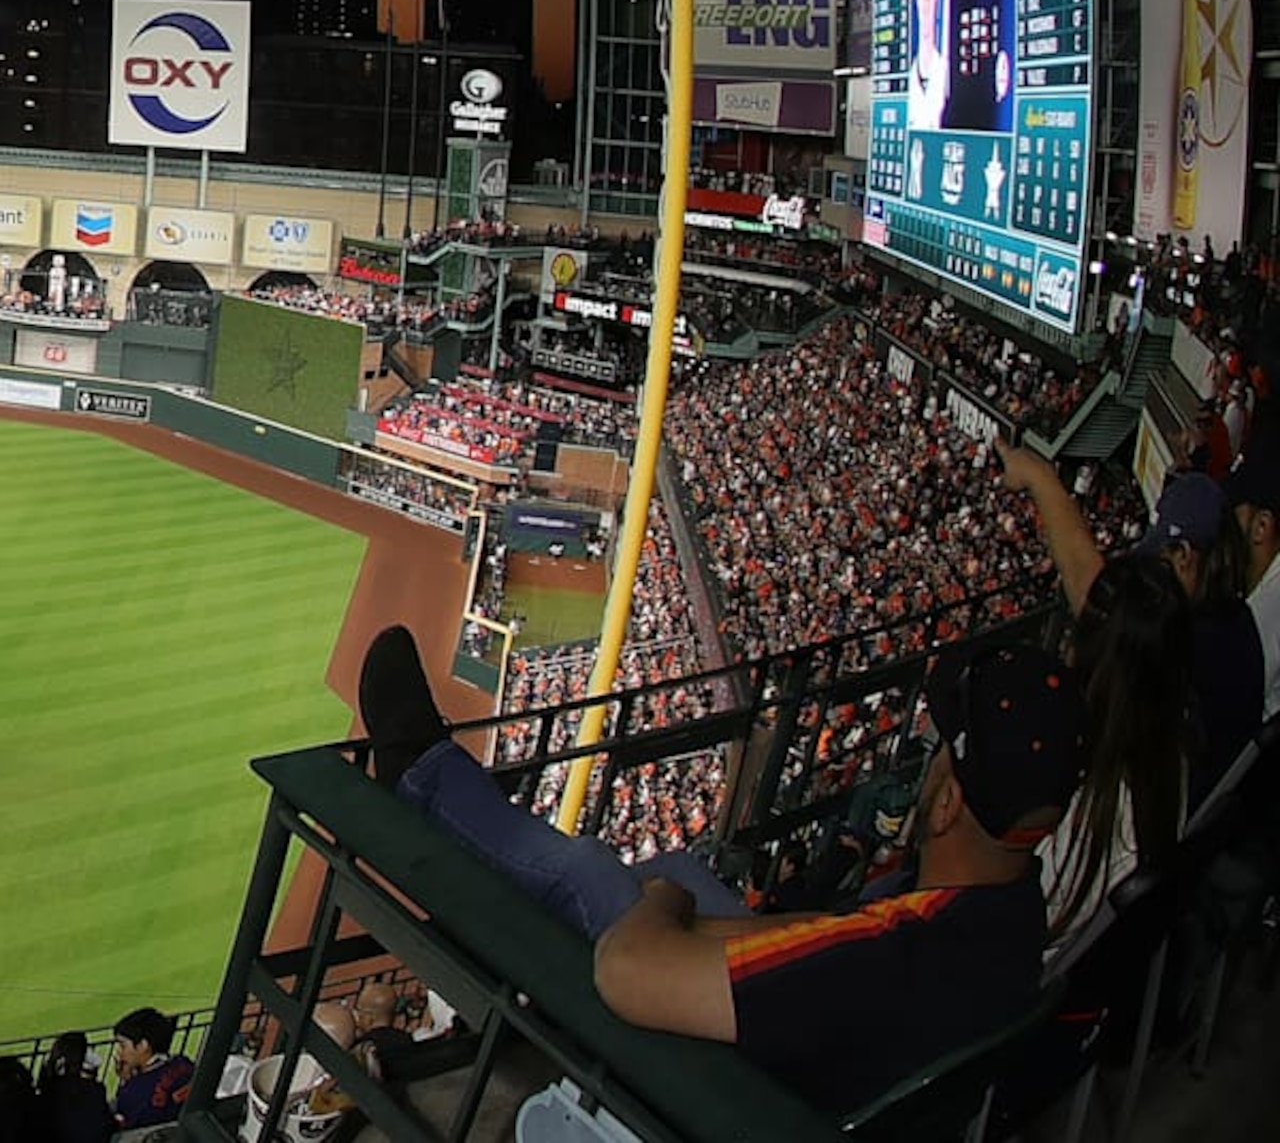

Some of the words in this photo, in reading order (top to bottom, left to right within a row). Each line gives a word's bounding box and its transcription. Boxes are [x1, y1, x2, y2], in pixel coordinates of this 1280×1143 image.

[695, 4, 809, 27] REEPORT
[124, 57, 233, 90] OXY
[565, 296, 618, 320] impact
[93, 393, 146, 413] VERITEX
